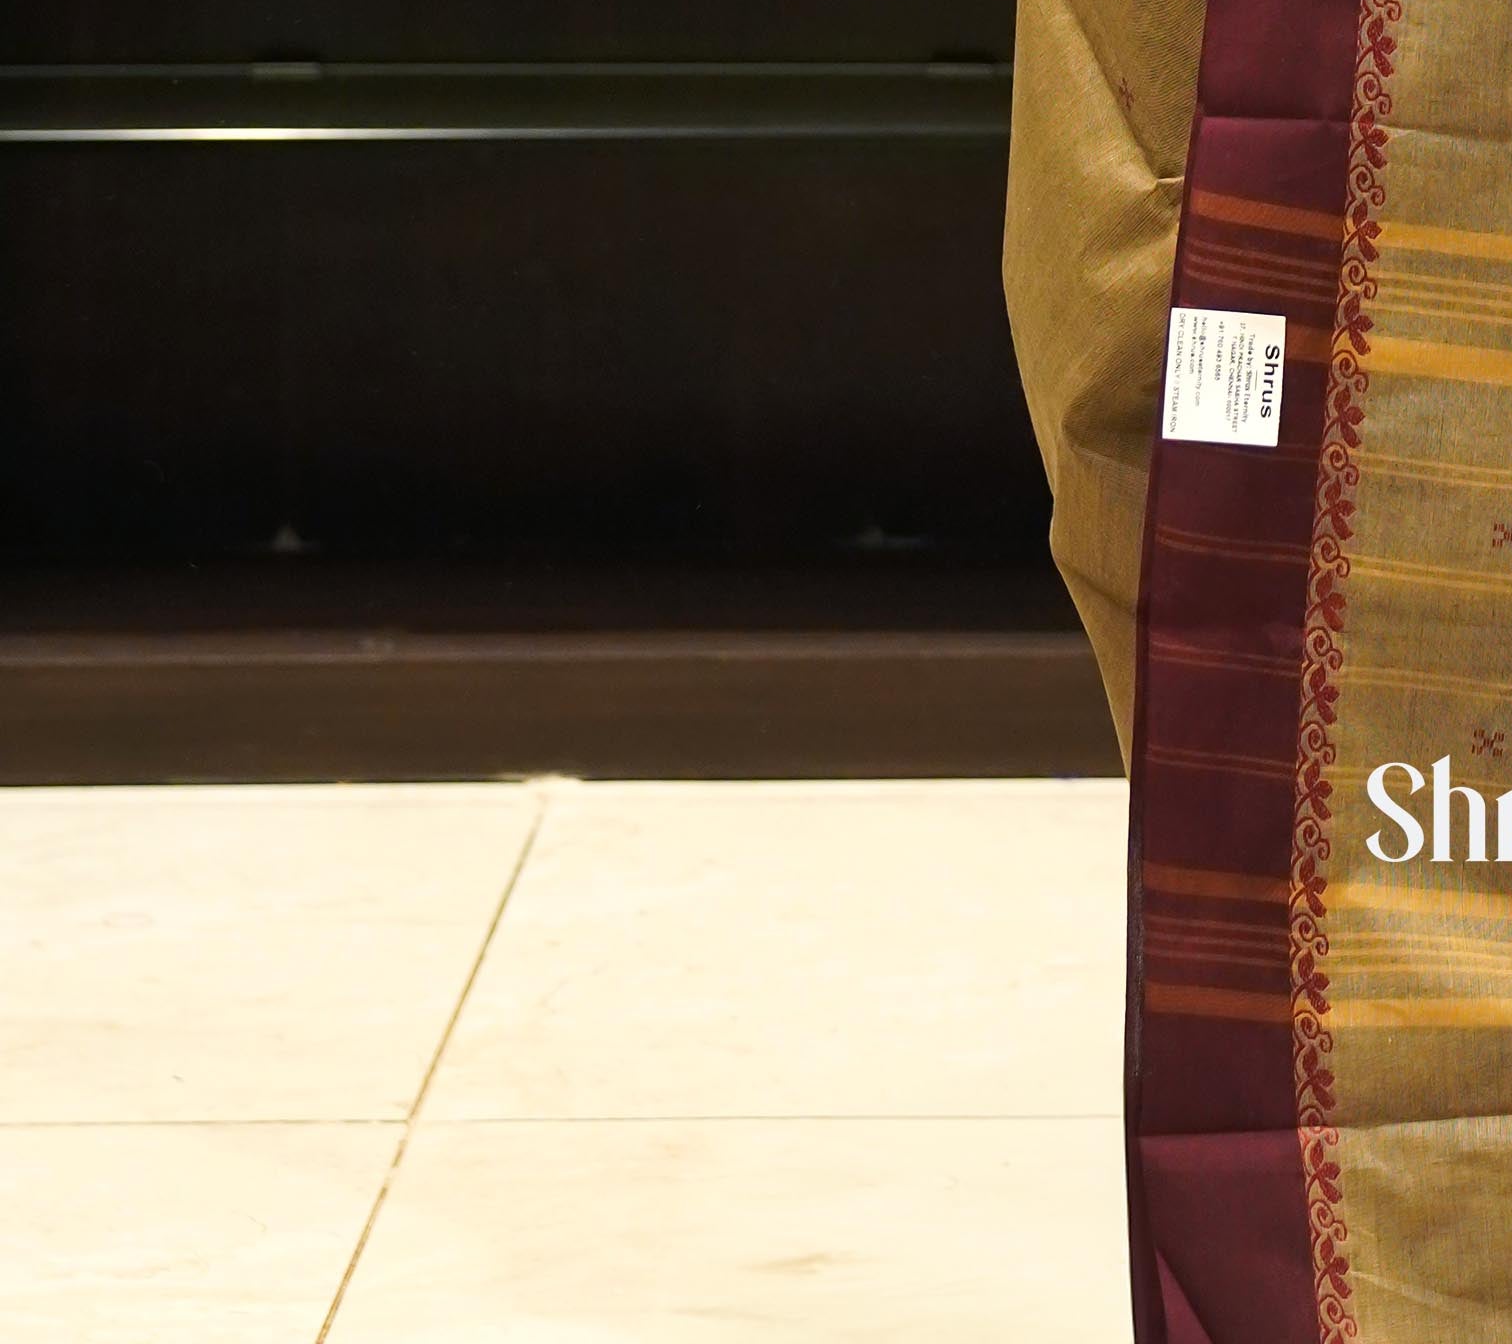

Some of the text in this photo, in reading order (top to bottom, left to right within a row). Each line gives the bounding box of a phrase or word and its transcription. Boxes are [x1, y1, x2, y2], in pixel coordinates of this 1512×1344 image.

[1175, 329, 1184, 356] CLEAN
[1173, 357, 1182, 378] ONLY
[1259, 343, 1281, 419] Shrus
[1170, 385, 1180, 412] STEAM
